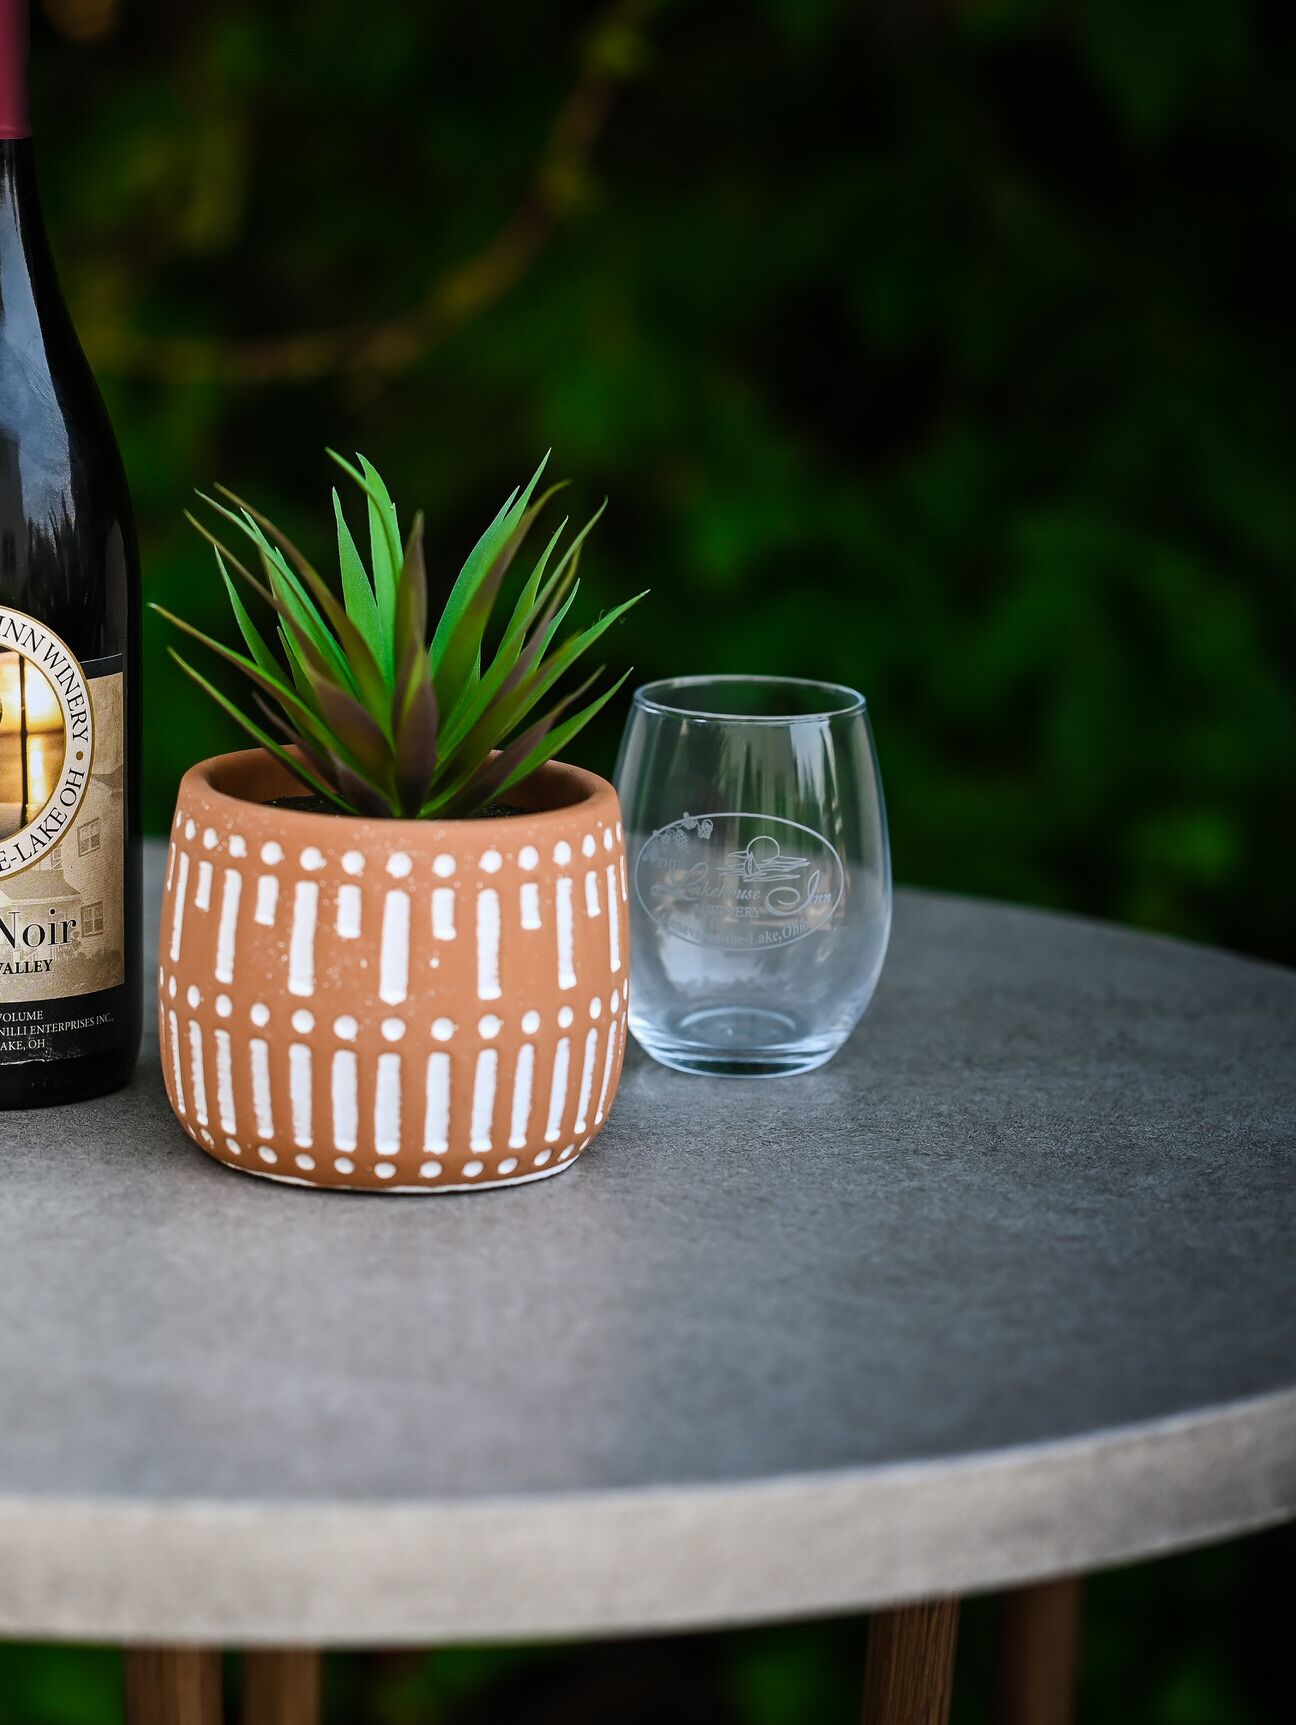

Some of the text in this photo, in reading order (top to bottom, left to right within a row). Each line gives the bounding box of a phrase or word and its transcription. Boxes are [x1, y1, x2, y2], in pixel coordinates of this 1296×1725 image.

[42, 642, 89, 743] WINERY
[59, 768, 85, 808] OH
[30, 1016, 95, 1035] ENTERPRISES
[96, 1012, 114, 1026] INC.
[28, 1038, 45, 1050] OH
